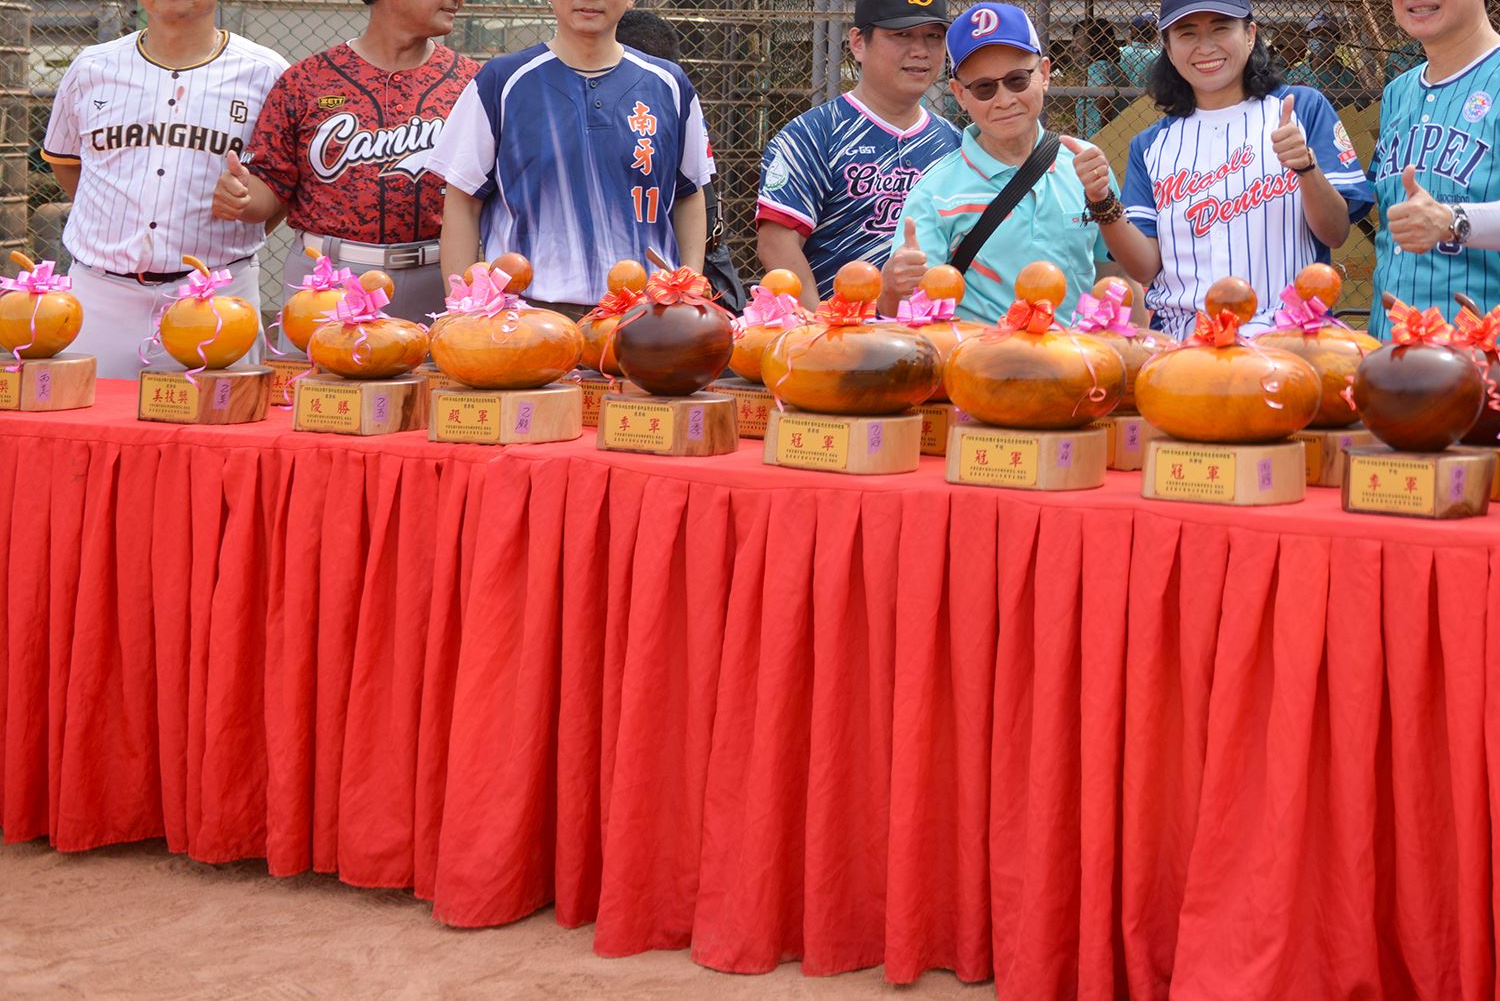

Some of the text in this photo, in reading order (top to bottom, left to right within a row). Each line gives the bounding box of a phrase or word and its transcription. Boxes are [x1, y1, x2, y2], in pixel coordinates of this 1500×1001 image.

[970, 8, 1000, 39] D
[90, 122, 244, 159] CHANGHUA
[627, 100, 657, 176] 南牙
[844, 163, 923, 199] Great
[1154, 144, 1254, 212] Miaoli
[631, 186, 659, 223] 11
[790, 432, 835, 451] 冠軍
[974, 449, 1023, 468] 冠軍
